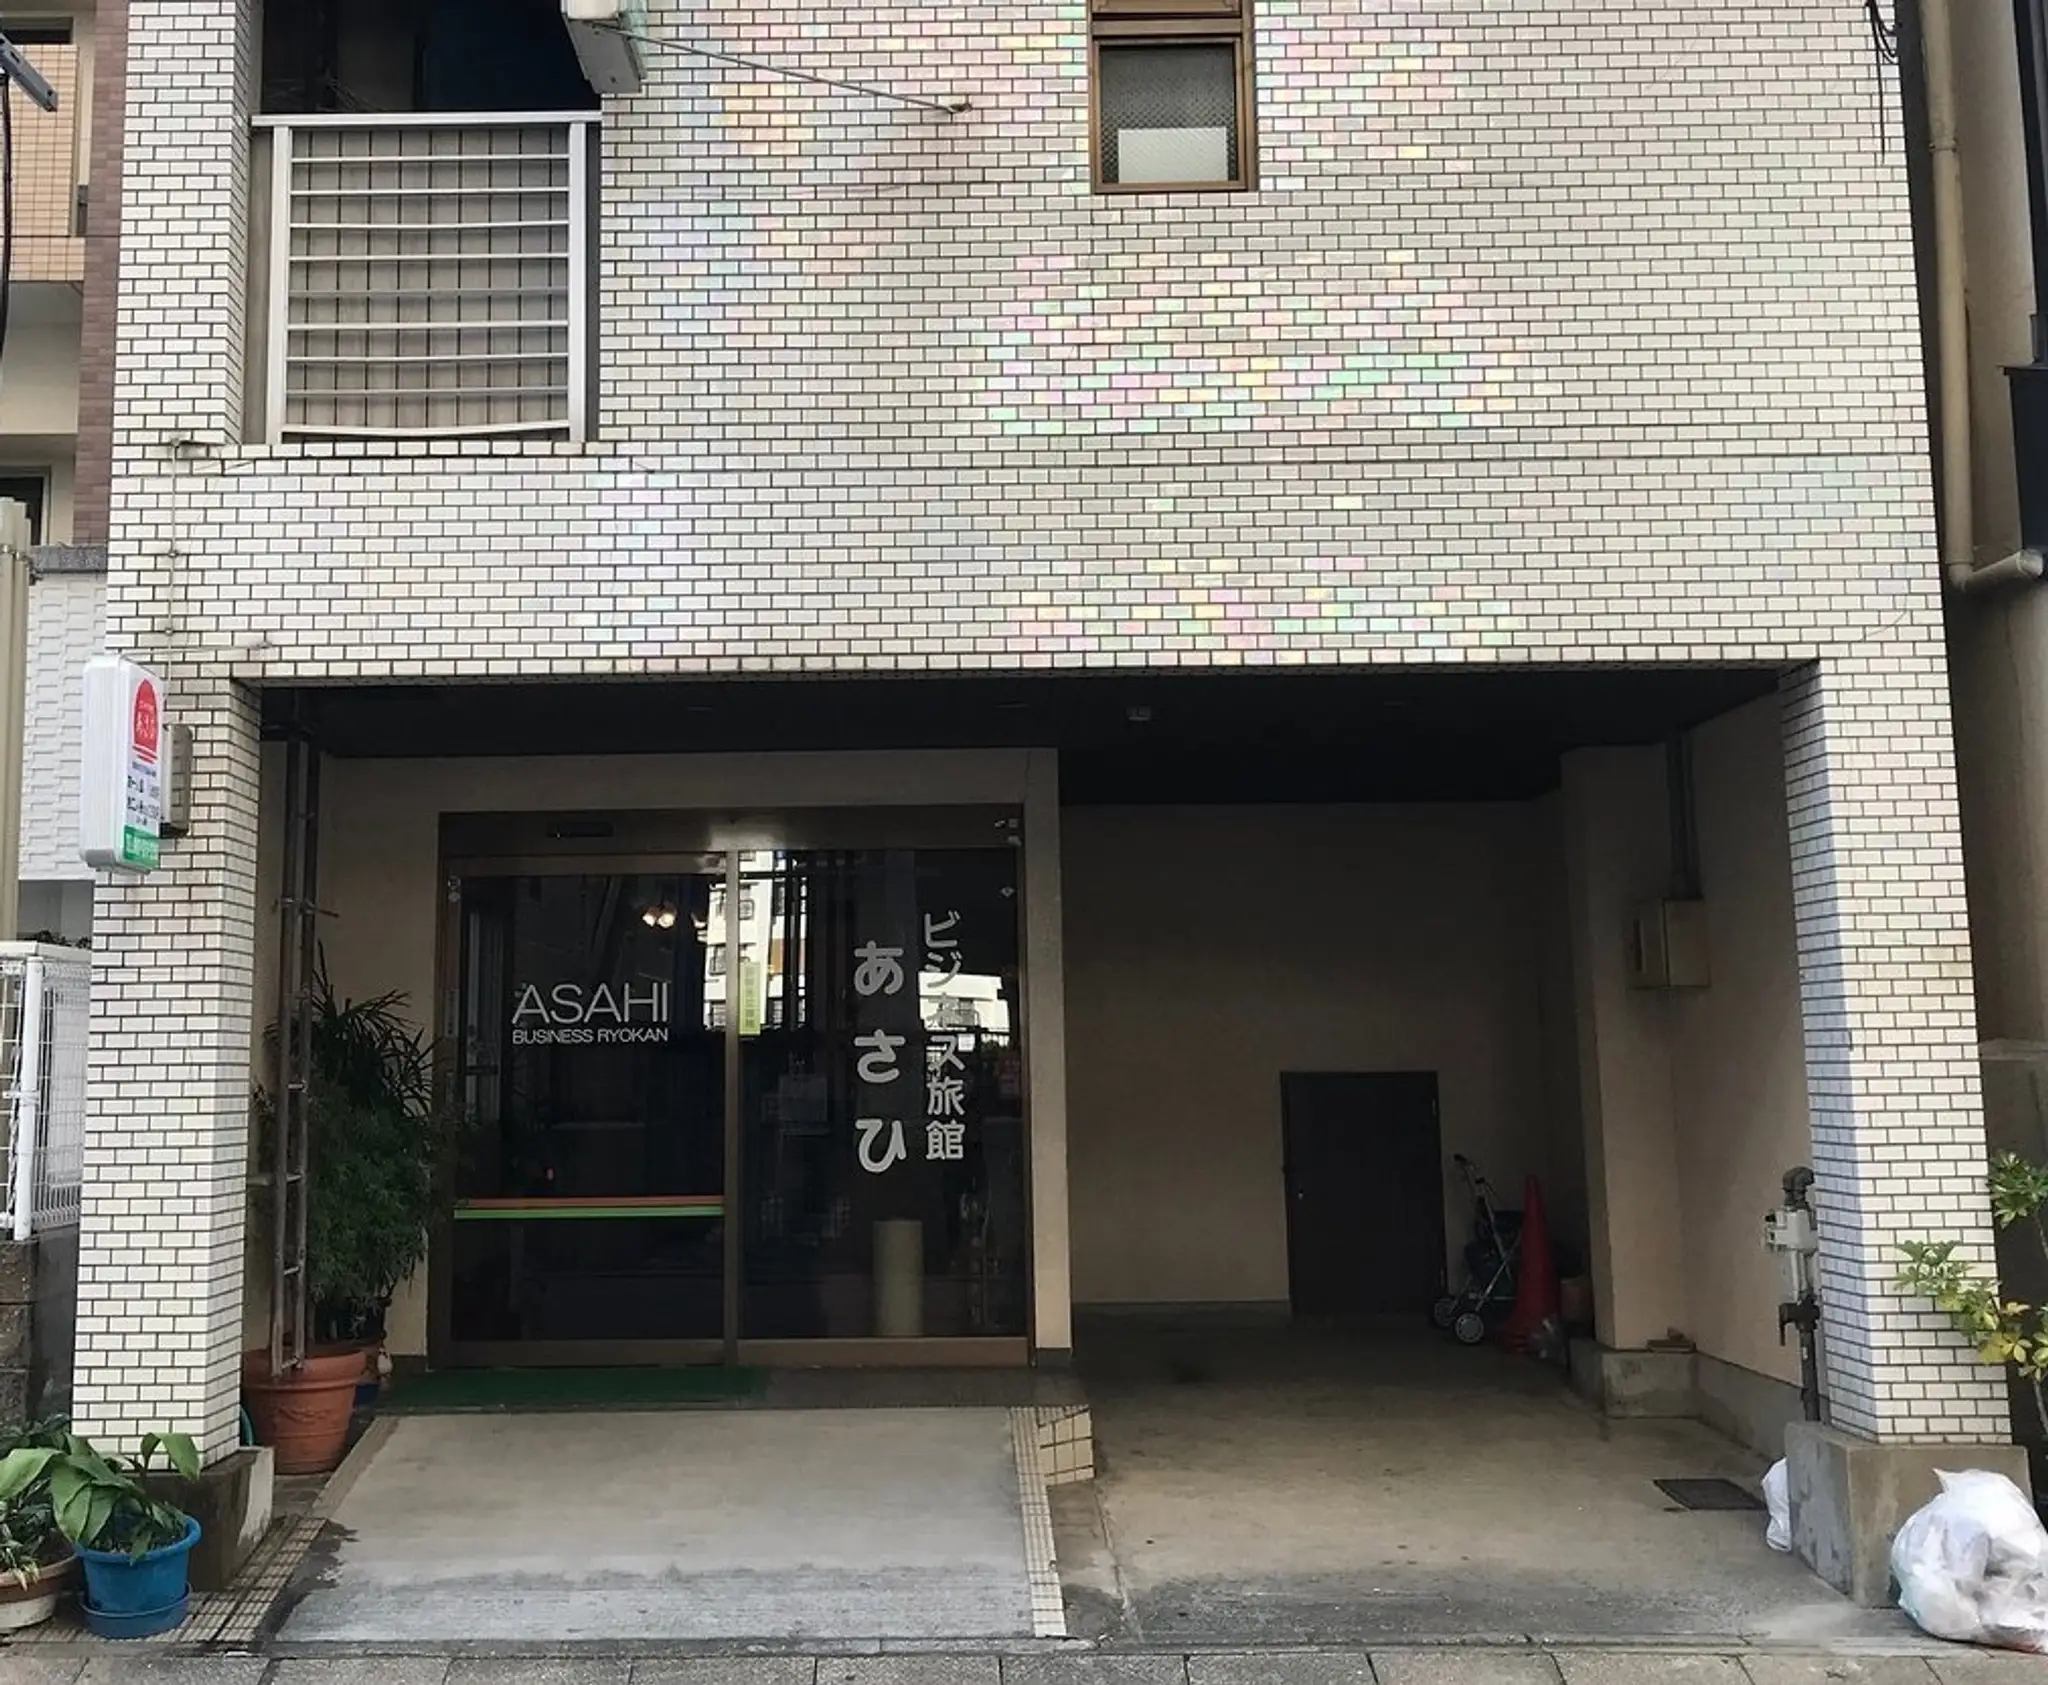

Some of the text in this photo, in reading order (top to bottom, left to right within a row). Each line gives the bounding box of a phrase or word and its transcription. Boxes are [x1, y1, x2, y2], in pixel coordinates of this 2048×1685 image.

[511, 983, 669, 1024] ASAHI
[512, 1028, 669, 1044] BUSINESS RYOKAN
[854, 940, 907, 1173] あさひ
[923, 910, 966, 1161] ビジネス旅館
